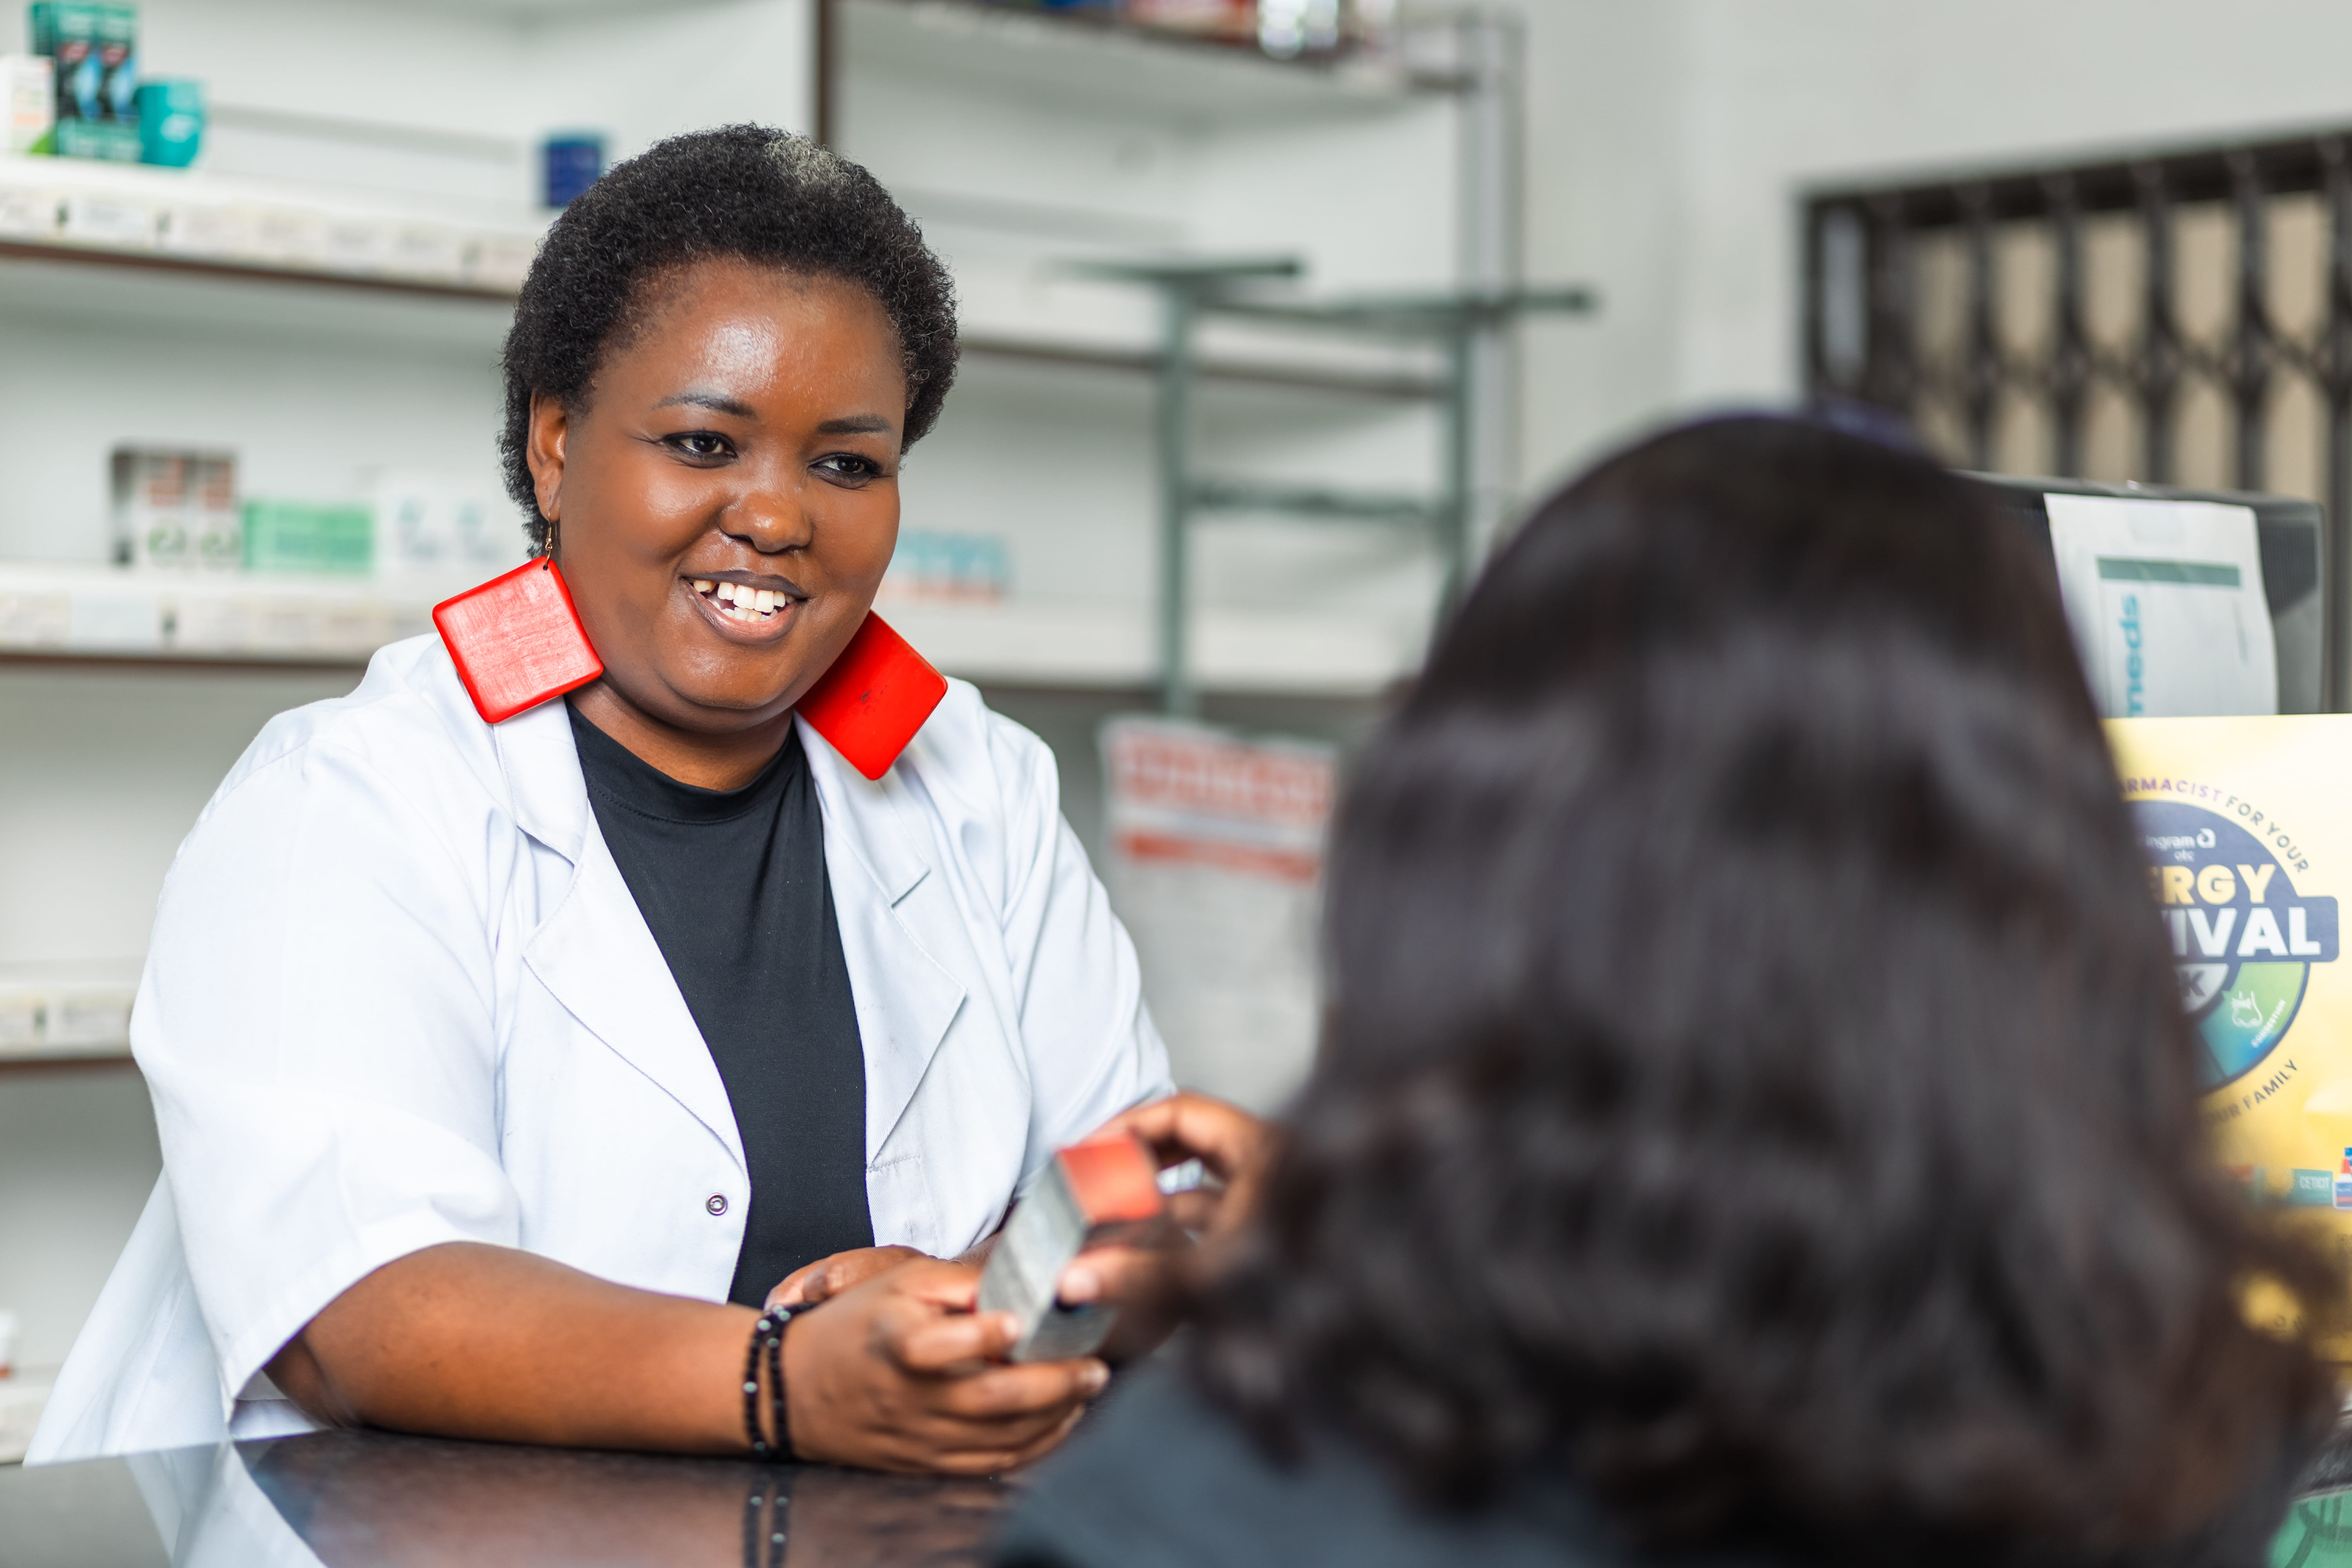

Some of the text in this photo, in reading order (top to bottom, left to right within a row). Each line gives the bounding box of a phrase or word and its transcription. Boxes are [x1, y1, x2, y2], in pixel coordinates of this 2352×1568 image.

[2226, 795, 2265, 826] FOR
[2267, 822, 2309, 873] YOUR
[2161, 906, 2322, 958] IVAL
[2250, 998, 2286, 1048] CONGESTION
[2242, 1058, 2297, 1110] FAMILY
